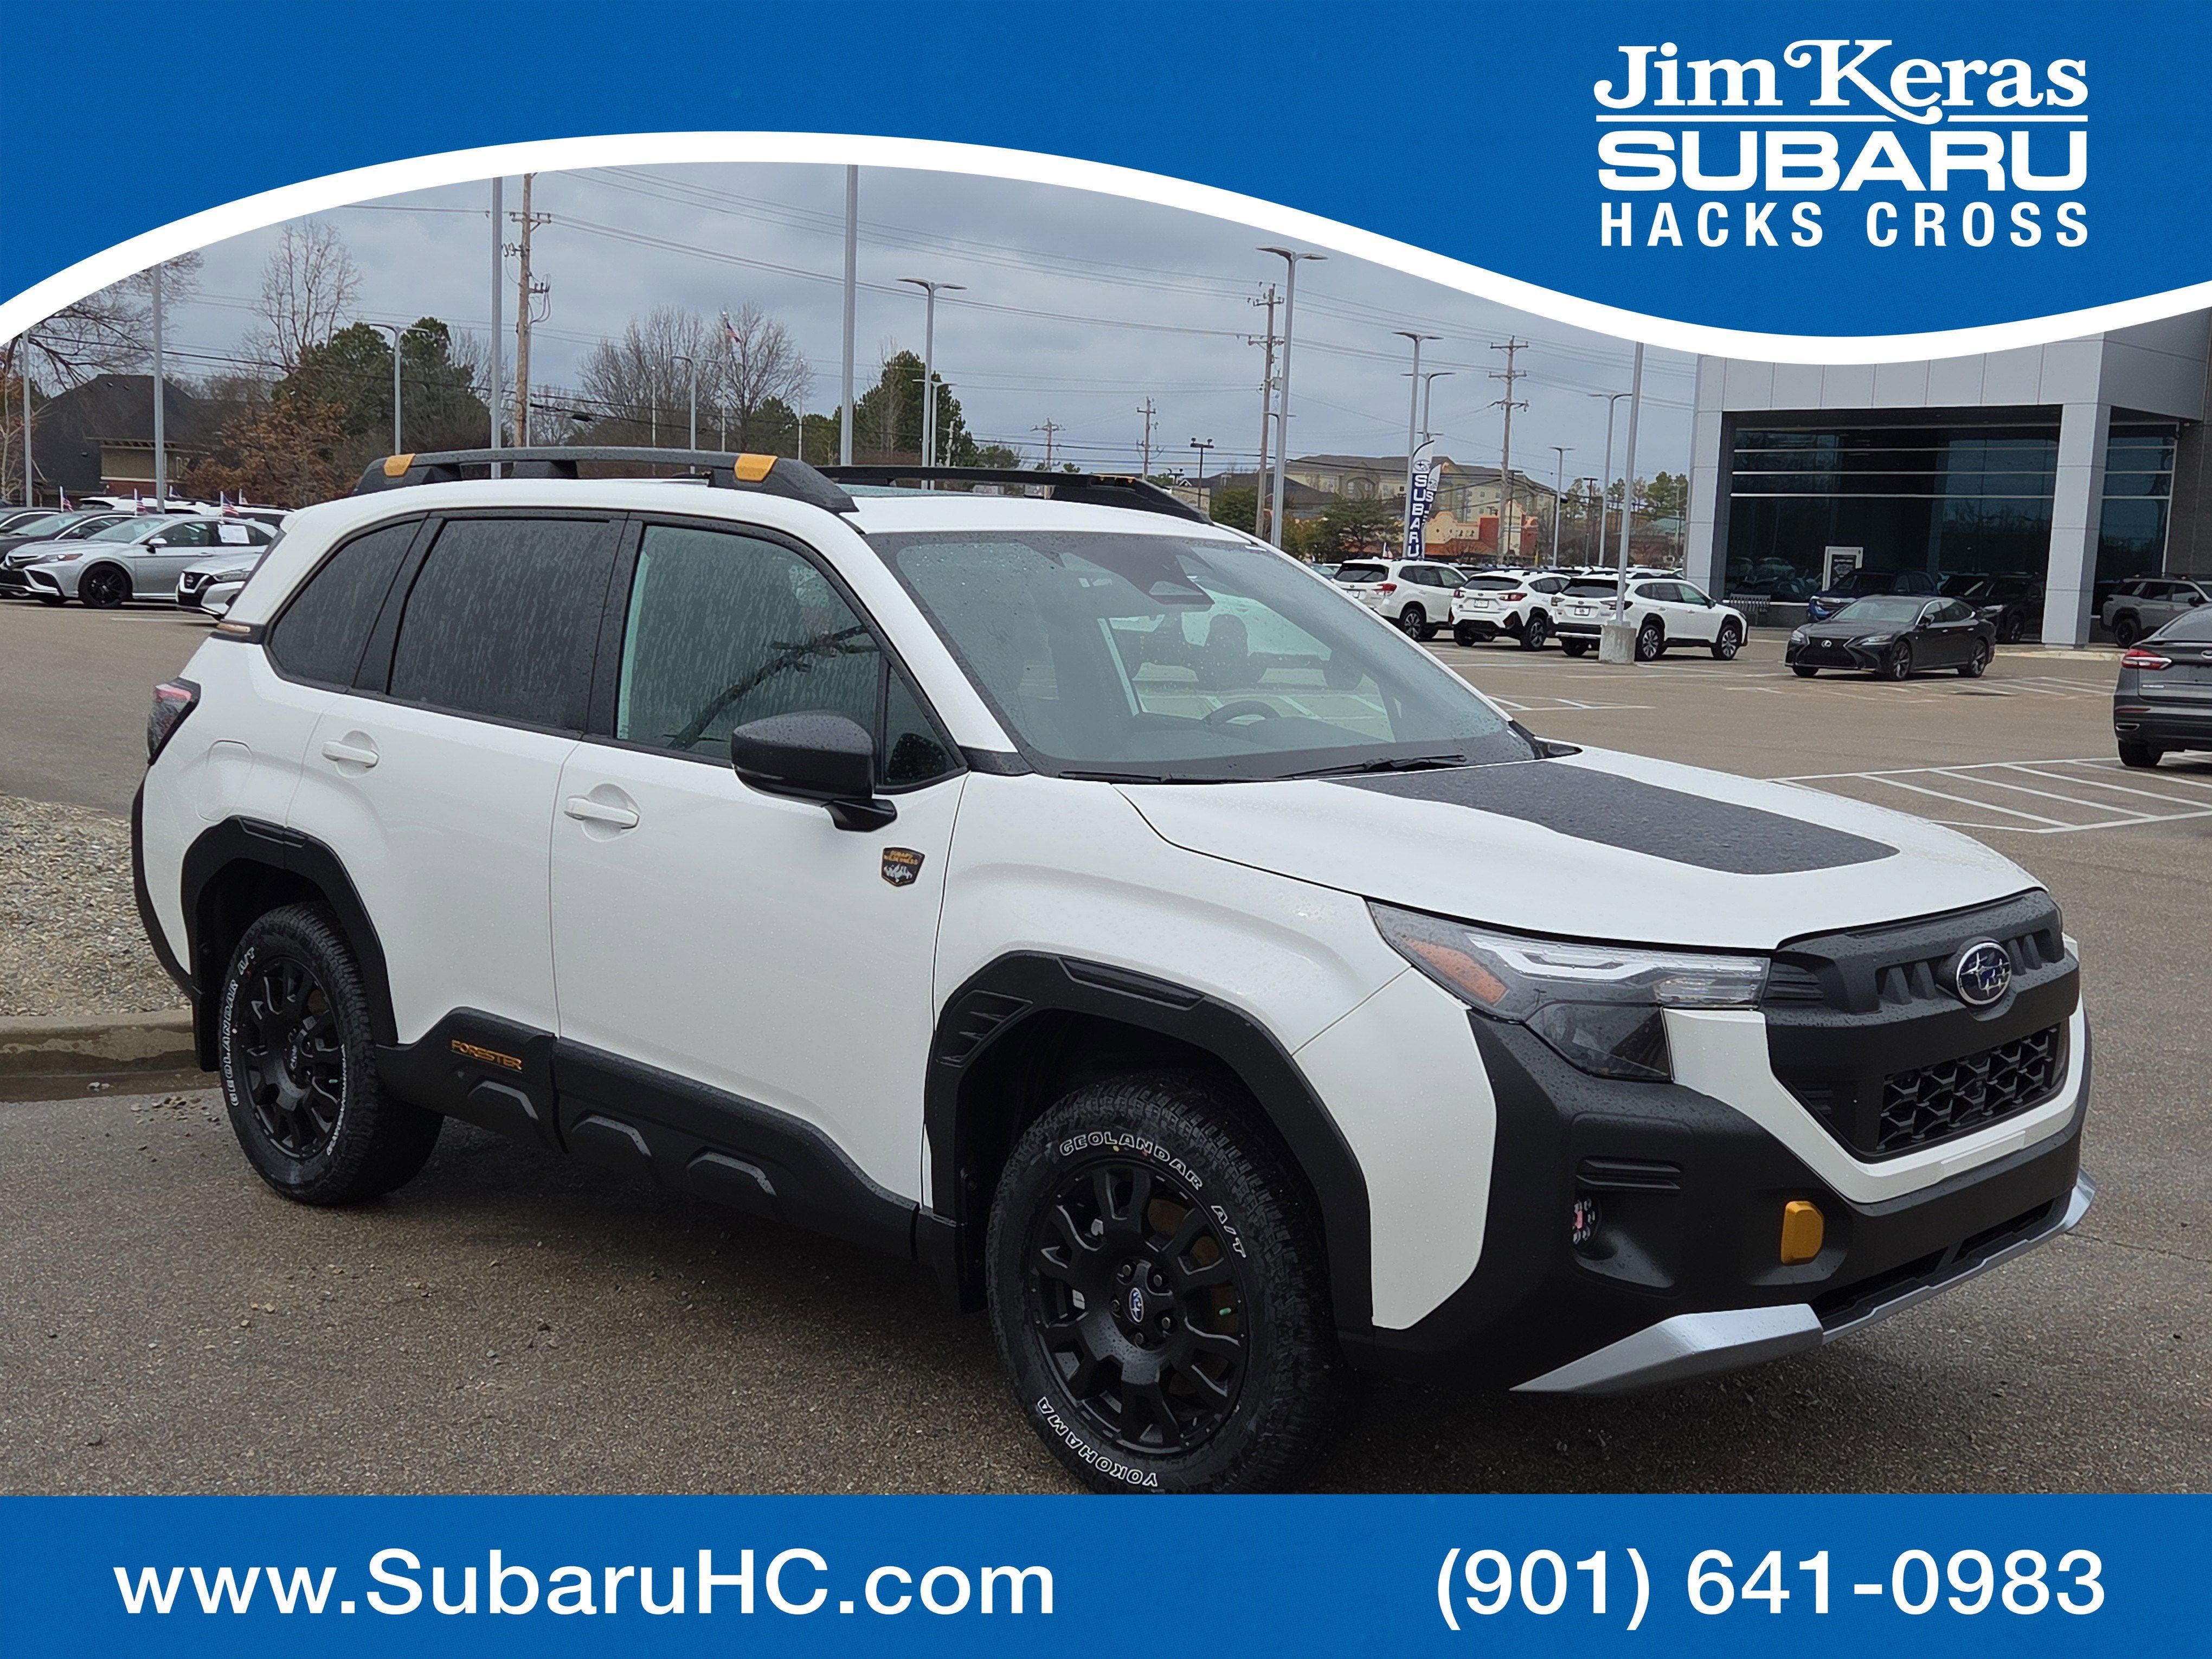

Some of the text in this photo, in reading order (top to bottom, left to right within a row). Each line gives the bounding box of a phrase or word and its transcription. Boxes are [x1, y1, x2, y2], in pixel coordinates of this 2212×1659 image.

[1407, 474, 1428, 557] SUBARU
[451, 1039, 522, 1070] FORESTER
[1059, 1131, 1246, 1258] GEOLANDAR A/T
[1037, 1397, 1158, 1487] YOKOHAMA
